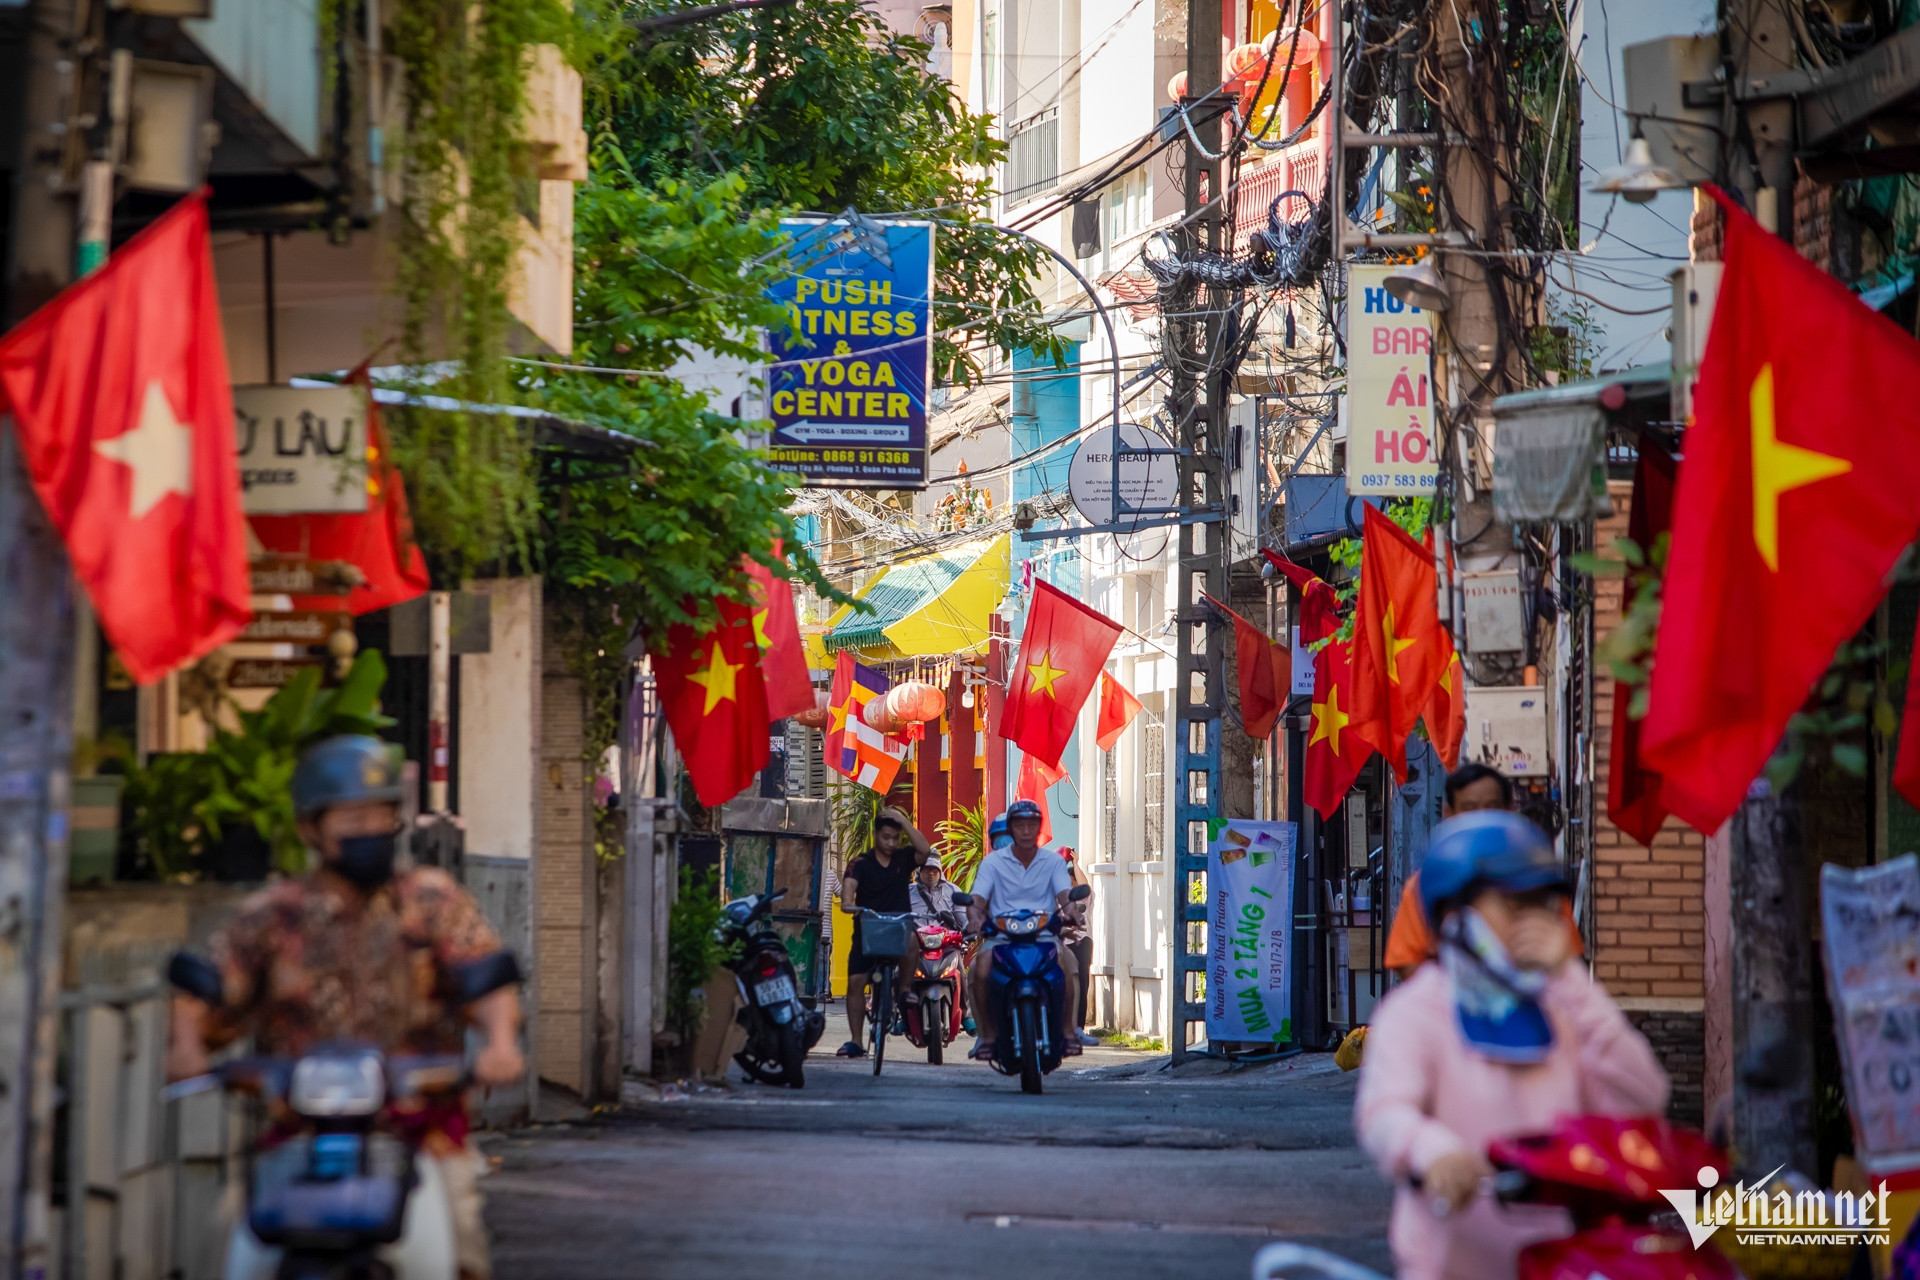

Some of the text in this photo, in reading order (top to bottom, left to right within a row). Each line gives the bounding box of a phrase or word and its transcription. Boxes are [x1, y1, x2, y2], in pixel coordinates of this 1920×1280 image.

[796, 279, 891, 305] PUSH
[785, 309, 917, 337] ITNESS
[833, 340, 852, 356] &
[1372, 326, 1431, 355] BAR
[800, 360, 896, 387] YOGA
[772, 389, 910, 418] CENTER
[816, 427, 835, 435] YOGA
[840, 428, 868, 436] BOXING
[1375, 415, 1438, 464] HỒ
[823, 450, 855, 462] 0868
[859, 451, 873, 463] 91
[877, 451, 909, 464] 6368
[1362, 474, 1439, 487] 0937 583 89
[1229, 885, 1273, 1034] MUA 2 TẶNG 1
[1270, 930, 1283, 974] 31/7-2/8
